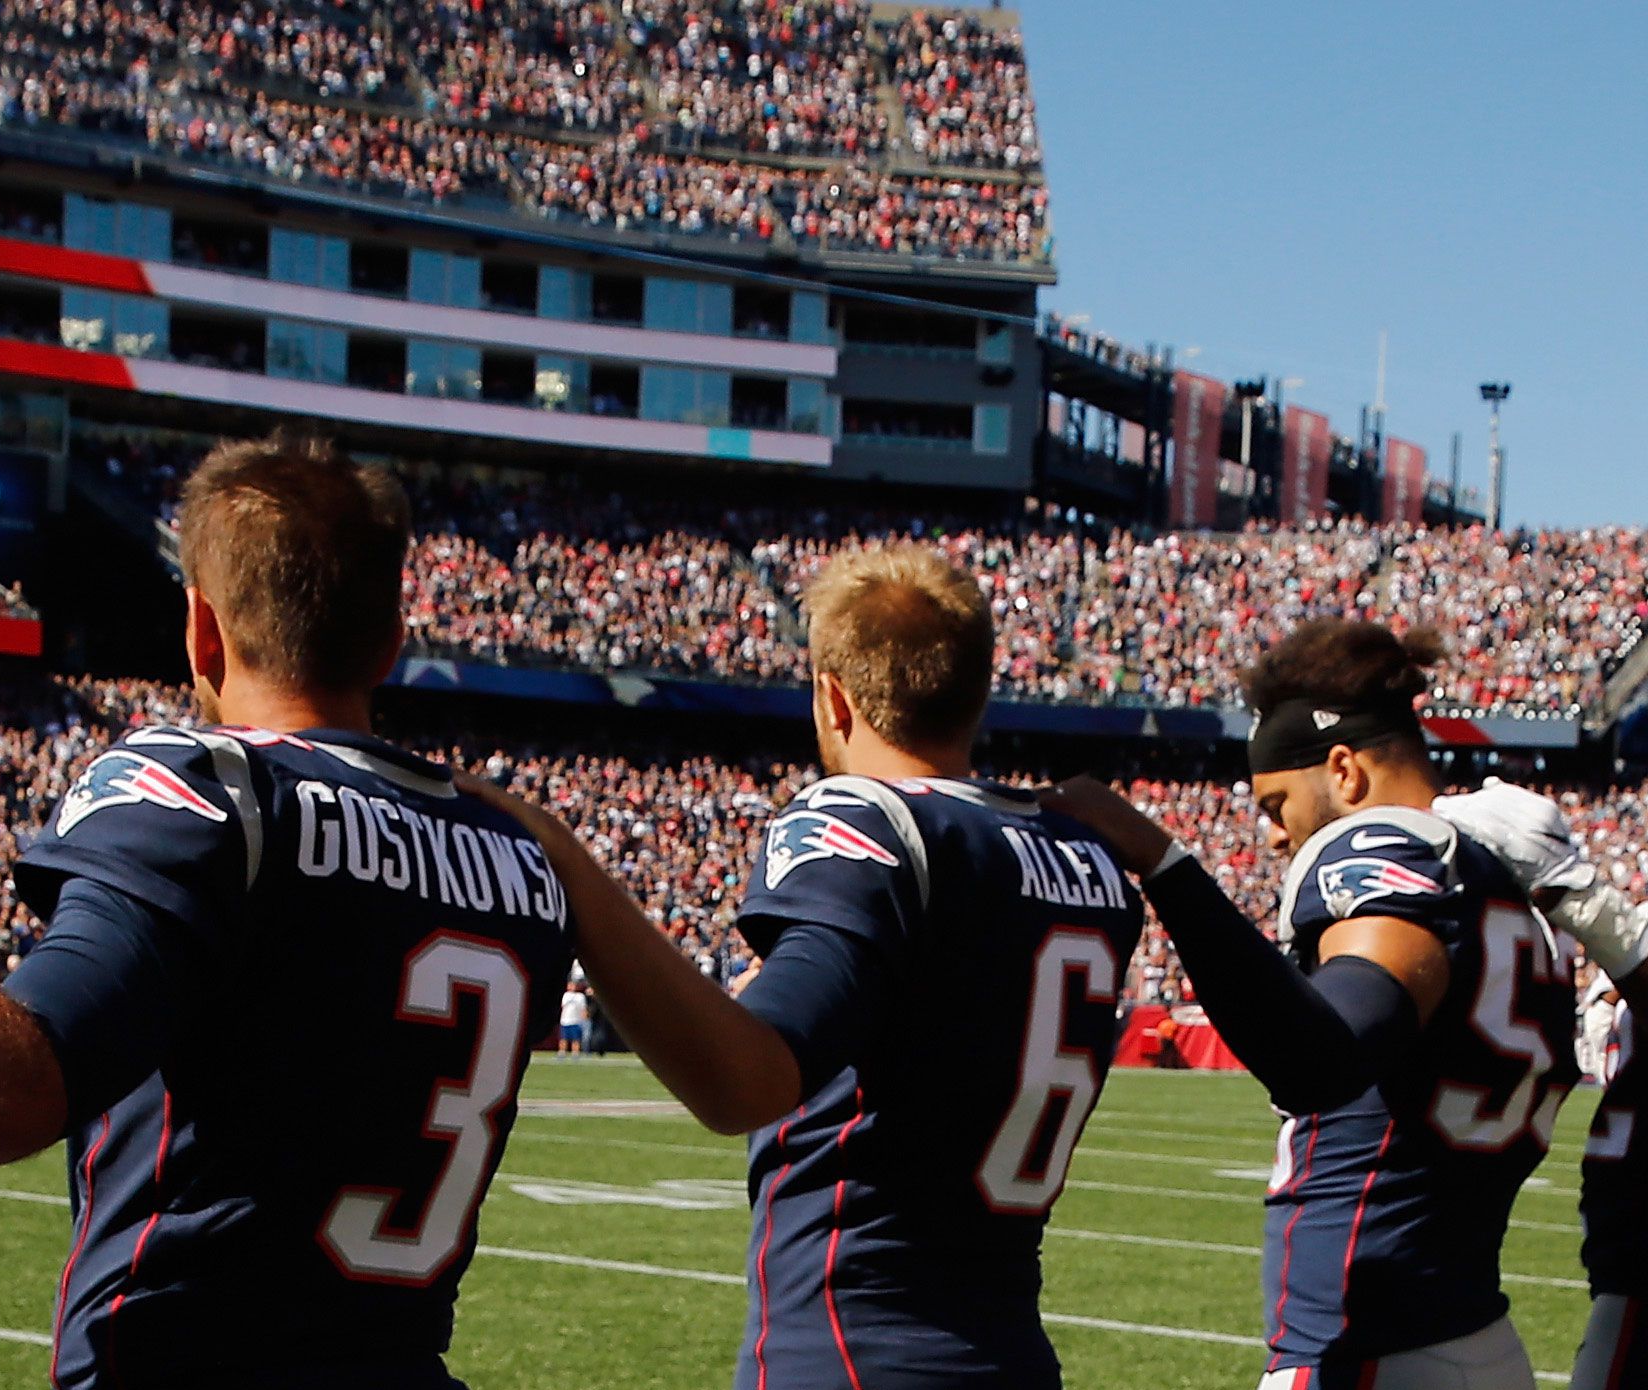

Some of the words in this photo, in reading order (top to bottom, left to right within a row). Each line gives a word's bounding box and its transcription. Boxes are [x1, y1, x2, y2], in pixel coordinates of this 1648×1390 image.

[1001, 826, 1127, 910] ALLEN
[314, 927, 531, 1289] 3
[972, 924, 1119, 1214] 6
